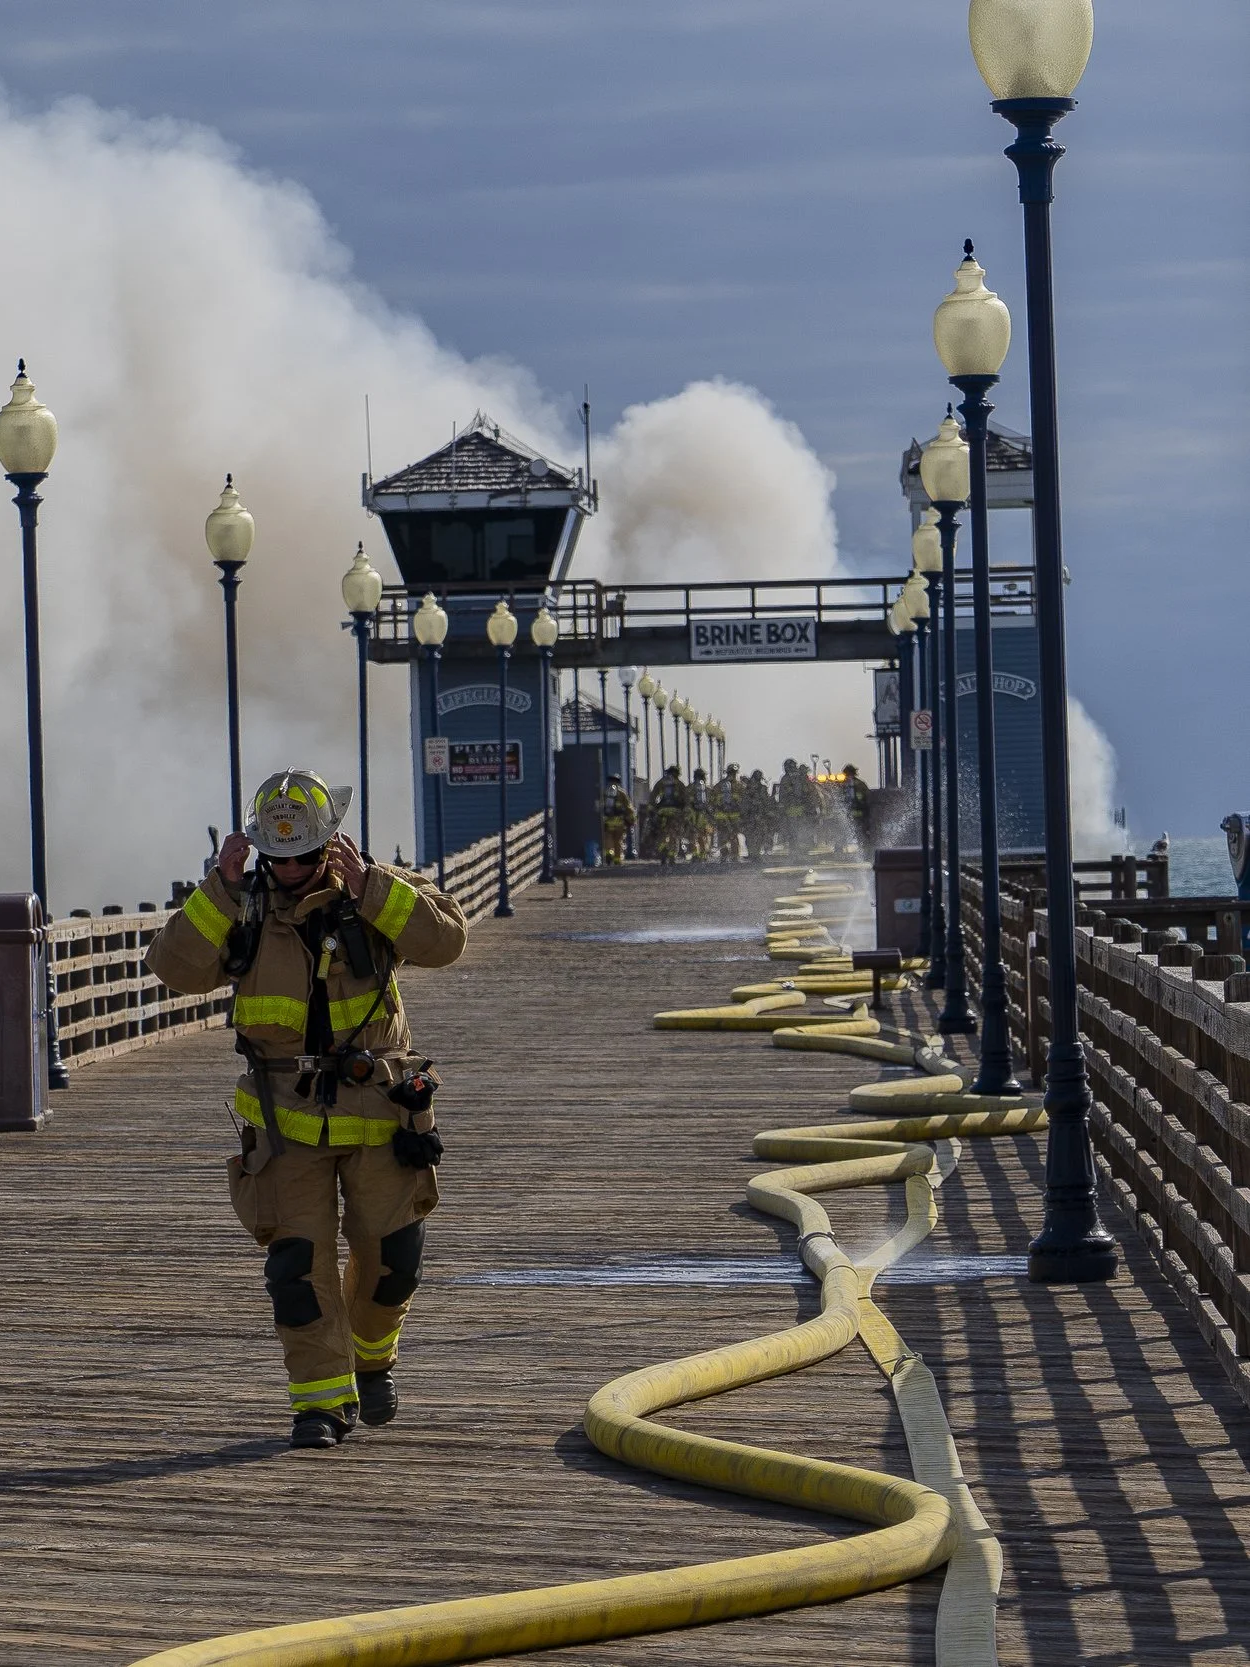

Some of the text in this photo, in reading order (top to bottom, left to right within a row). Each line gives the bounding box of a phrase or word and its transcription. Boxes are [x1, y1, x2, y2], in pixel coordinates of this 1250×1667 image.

[695, 621, 810, 647] BRINE BOX
[993, 675, 1026, 692] HOP
[264, 803, 302, 813] ASSISTANT CHIEF
